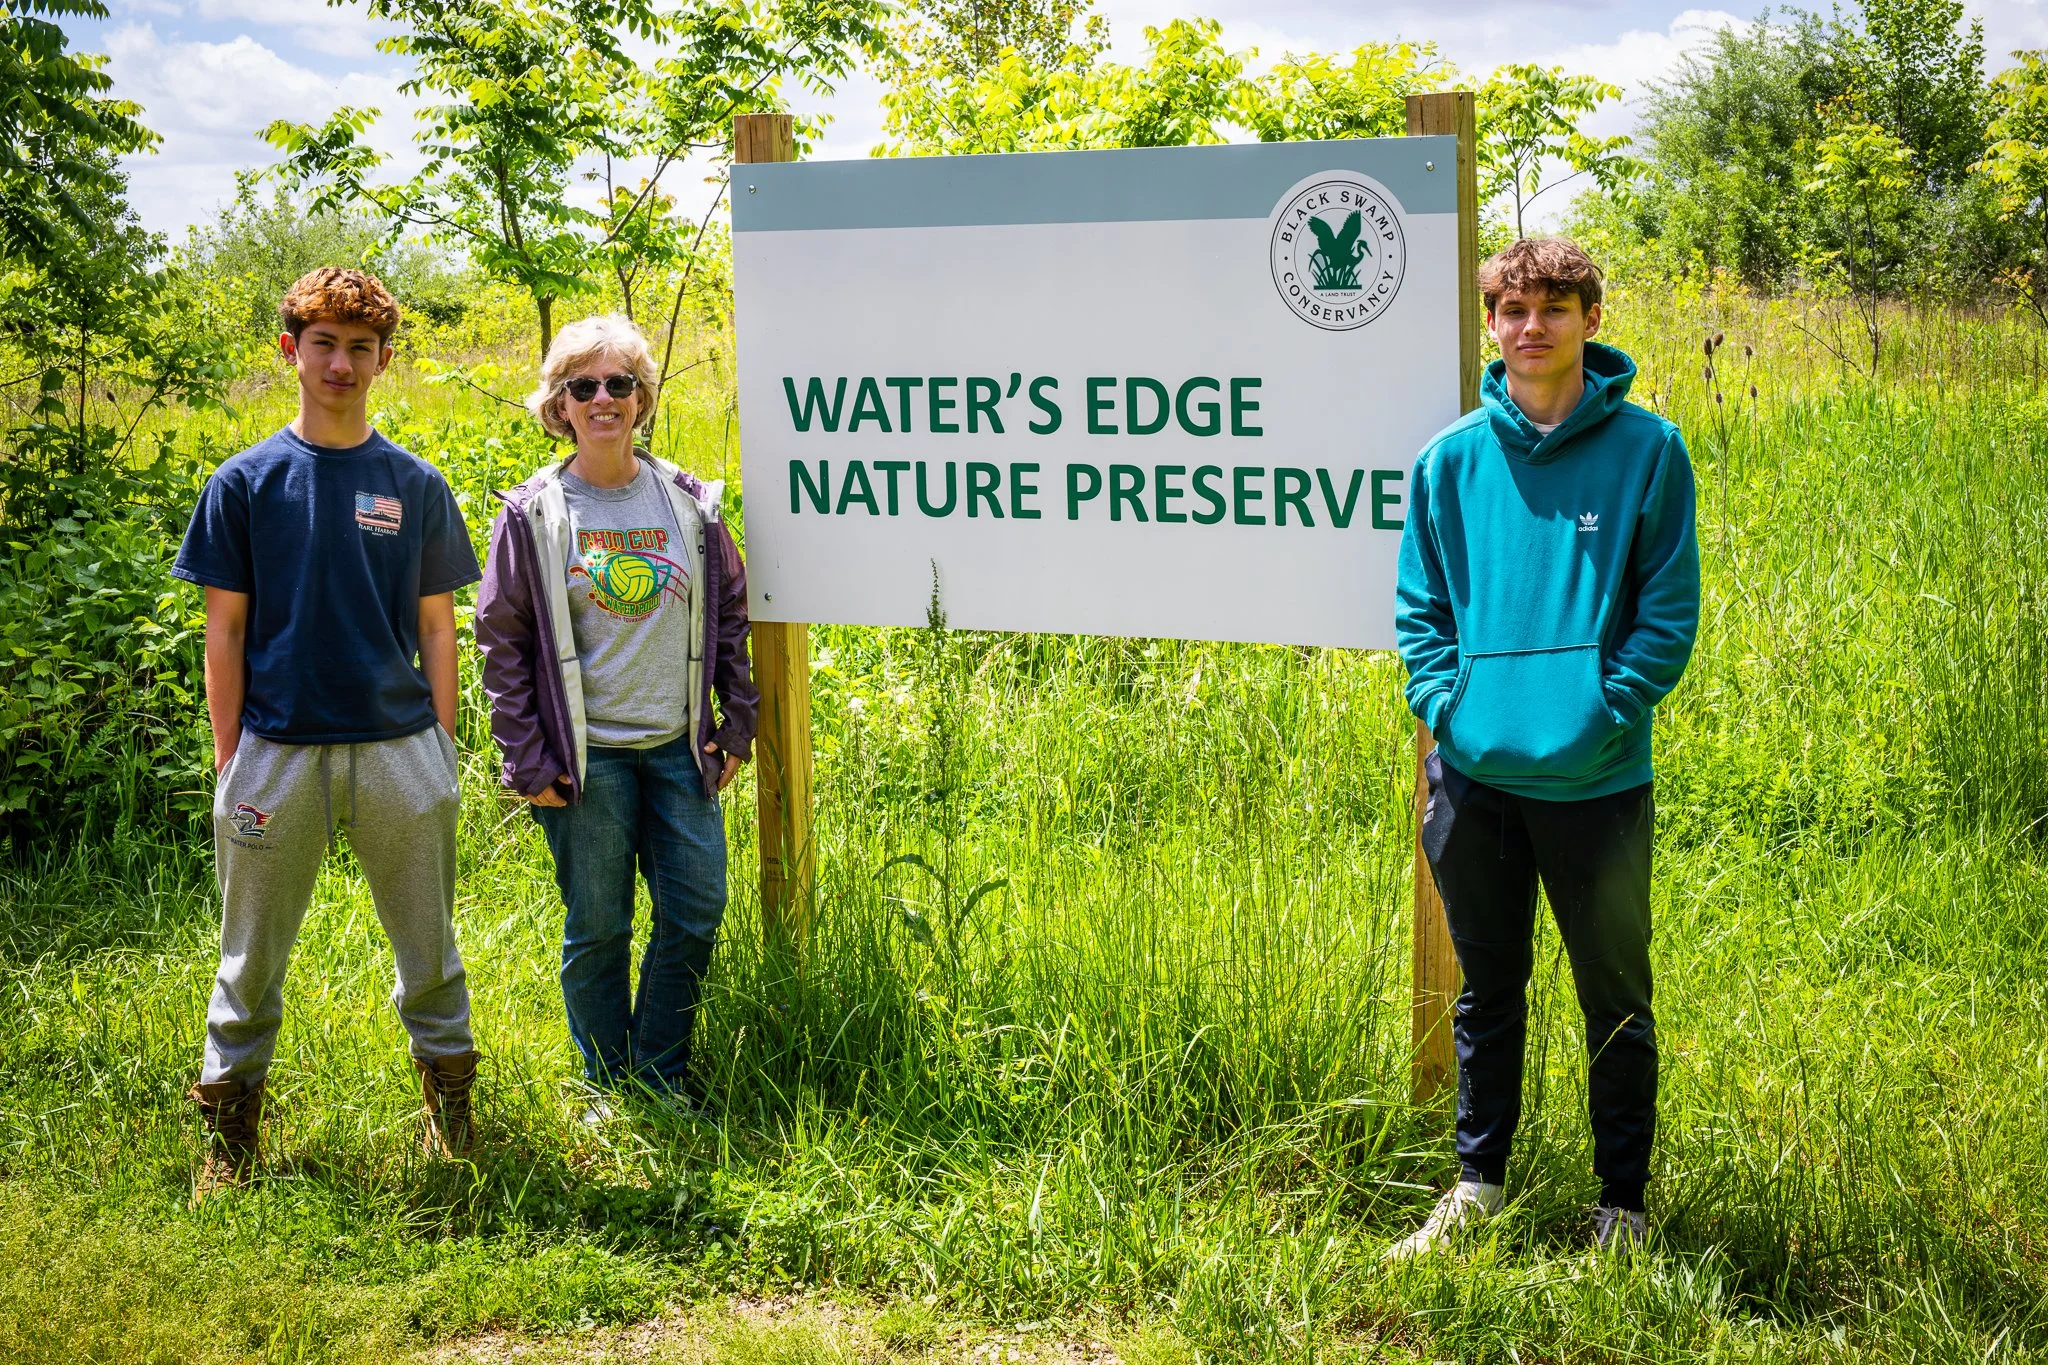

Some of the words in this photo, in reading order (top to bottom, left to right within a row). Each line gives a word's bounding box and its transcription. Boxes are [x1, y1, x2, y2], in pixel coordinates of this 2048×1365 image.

[1281, 191, 1331, 243] BLACK
[1340, 191, 1395, 242] SWAMP
[1283, 270, 1395, 322] CONSERVANCY
[782, 373, 1063, 434] WATER'S
[1086, 376, 1264, 437] EDGE
[788, 459, 1042, 520] NATURE
[1066, 463, 1405, 530] PRESERVE
[374, 526, 398, 536] HARBOR
[578, 529, 625, 556] OHIO
[627, 528, 669, 553] CUP
[605, 595, 636, 615] WATER
[638, 594, 660, 615] POLO
[247, 843, 264, 851] POLO
